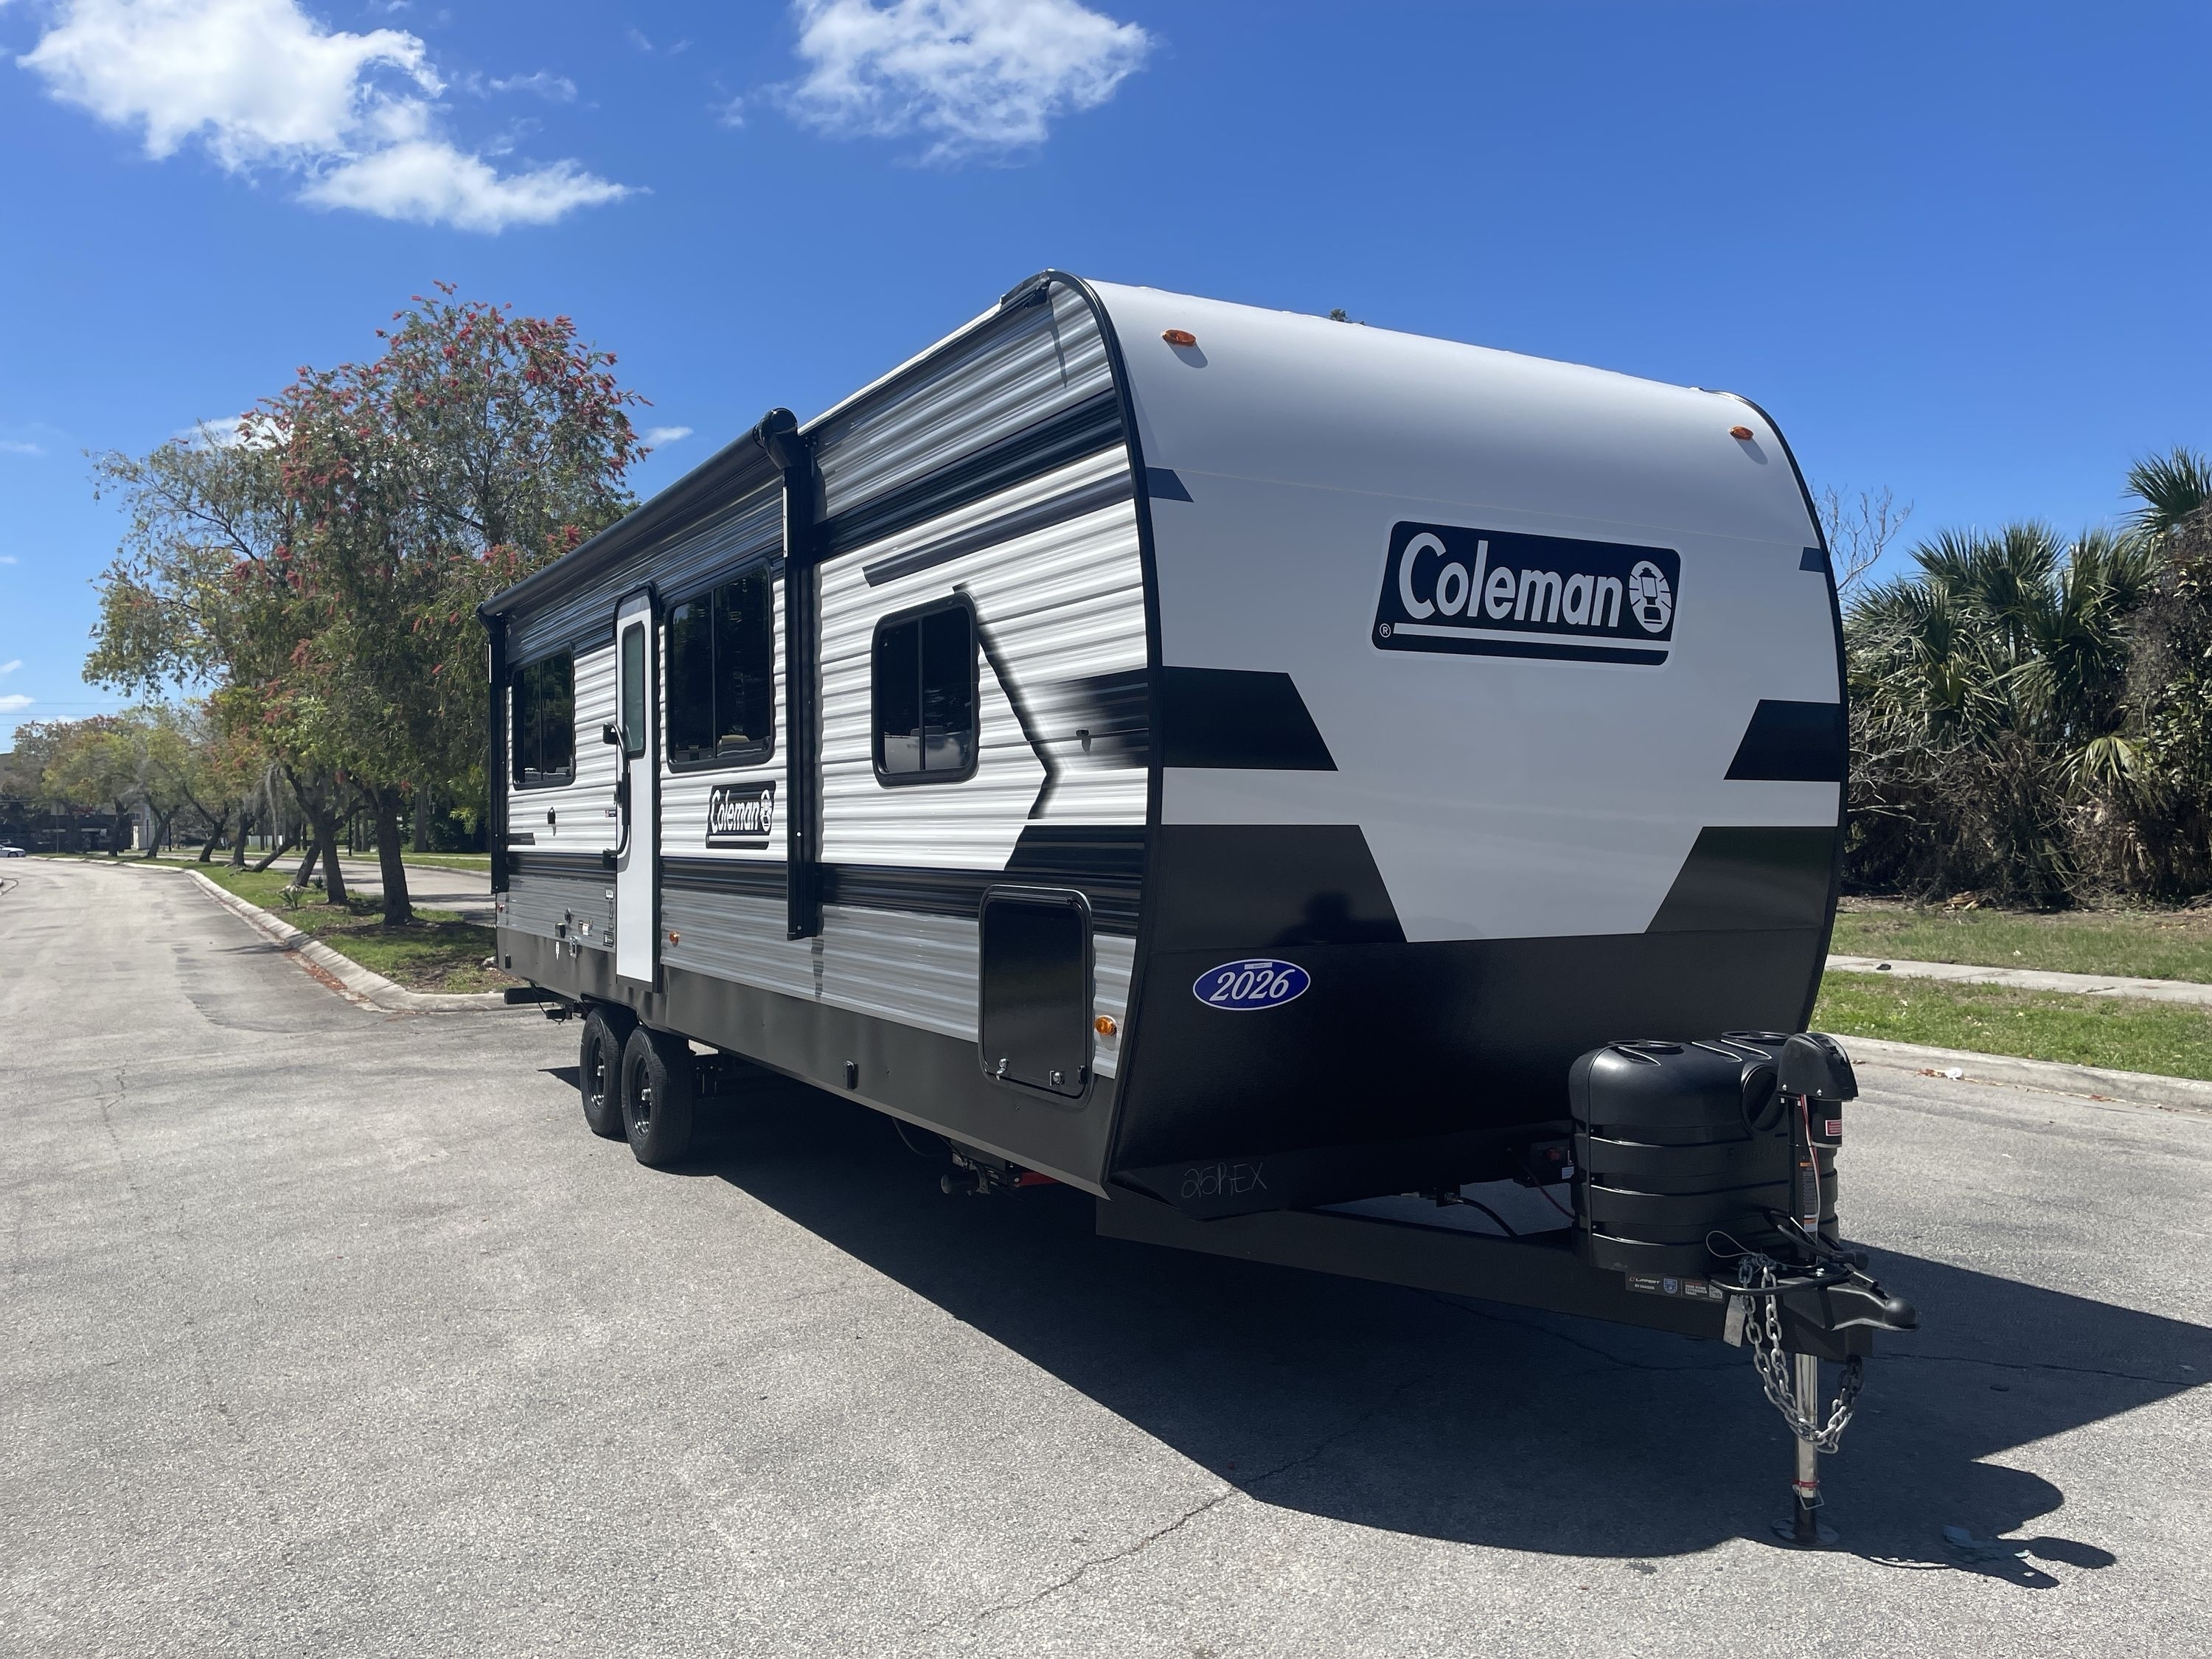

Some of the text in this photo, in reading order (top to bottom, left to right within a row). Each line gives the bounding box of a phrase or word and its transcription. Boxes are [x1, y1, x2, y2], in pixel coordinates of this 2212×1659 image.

[1399, 532, 1623, 628] Coleman
[710, 789, 760, 834] Coleman
[1208, 969, 1295, 1001] 2026
